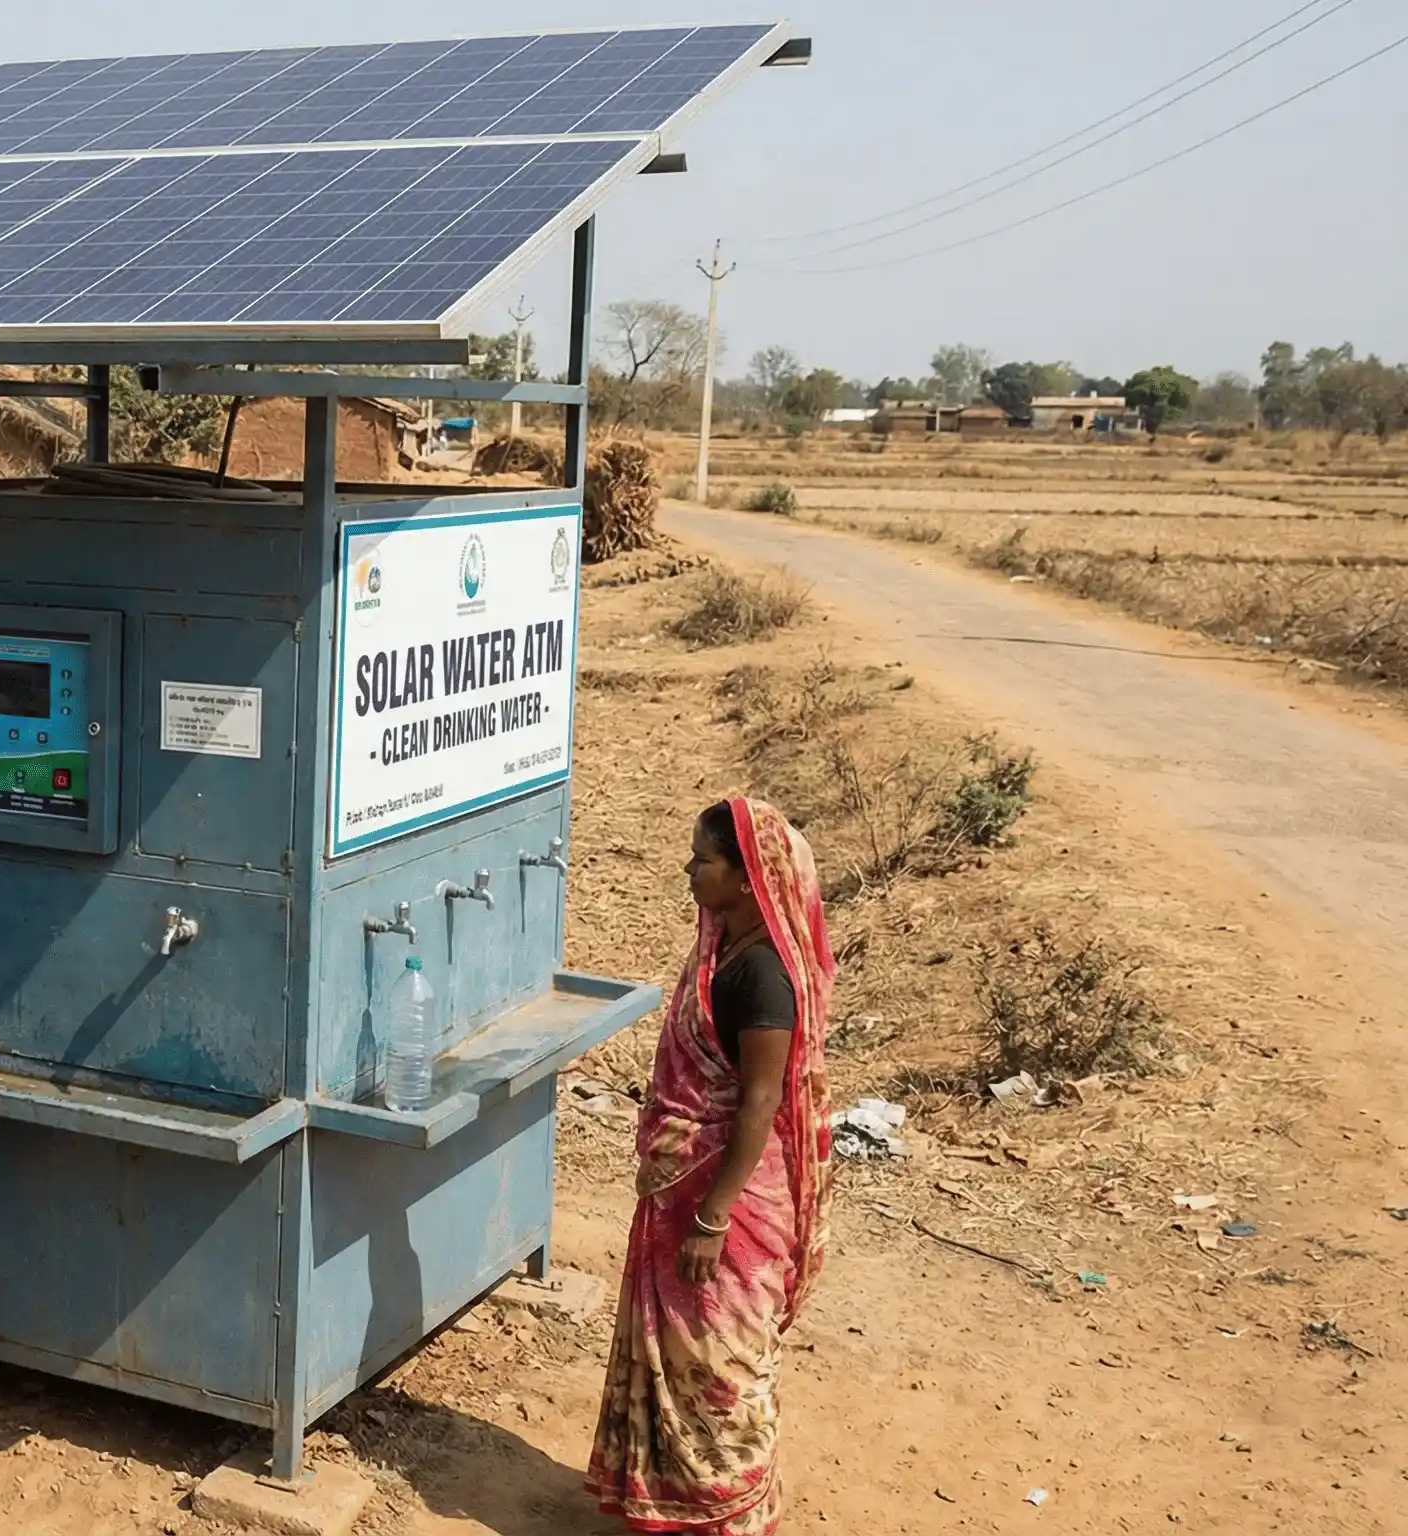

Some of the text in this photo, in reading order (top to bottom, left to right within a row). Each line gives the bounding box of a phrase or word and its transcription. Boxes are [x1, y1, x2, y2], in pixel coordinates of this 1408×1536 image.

[355, 619, 564, 717] SOLAR WATER ATM
[381, 716, 429, 766] CLEAN
[433, 702, 496, 752] DRINKING
[500, 691, 542, 733] WATER
